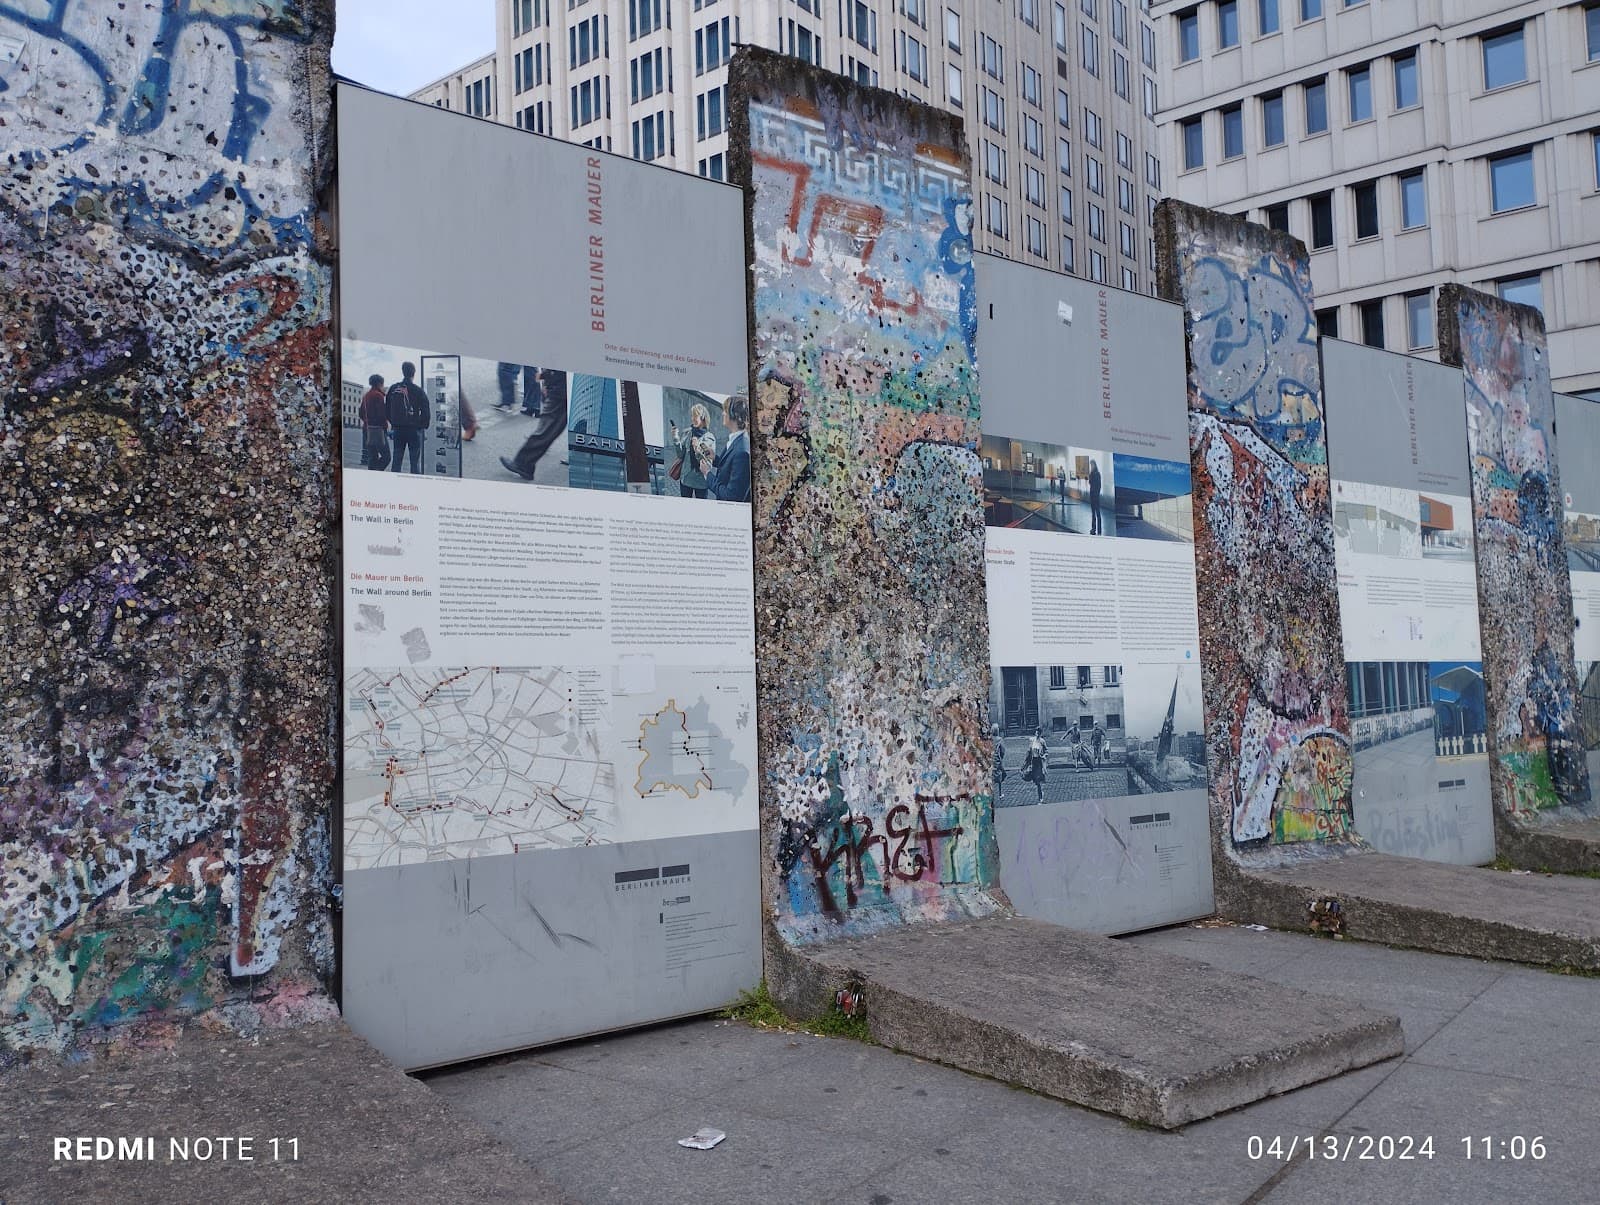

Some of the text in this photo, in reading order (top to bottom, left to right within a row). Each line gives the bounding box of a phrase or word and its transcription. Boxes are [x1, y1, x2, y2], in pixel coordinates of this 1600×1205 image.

[587, 156, 605, 332] BERLINER MAUER
[662, 352, 674, 361] und
[1098, 289, 1112, 419] BERLINER MAUER
[605, 355, 687, 374] Remembering the Berlin Wall
[575, 433, 662, 457] BAHNF
[350, 499, 362, 508] Die
[364, 500, 387, 510] Mauer
[398, 502, 419, 512] Berlin
[350, 513, 364, 522] The
[366, 515, 382, 524] Wall
[393, 517, 414, 526] Berlin
[350, 572, 424, 583] Die Mauer um Berlin
[350, 587, 432, 597] The Wall around Berlin
